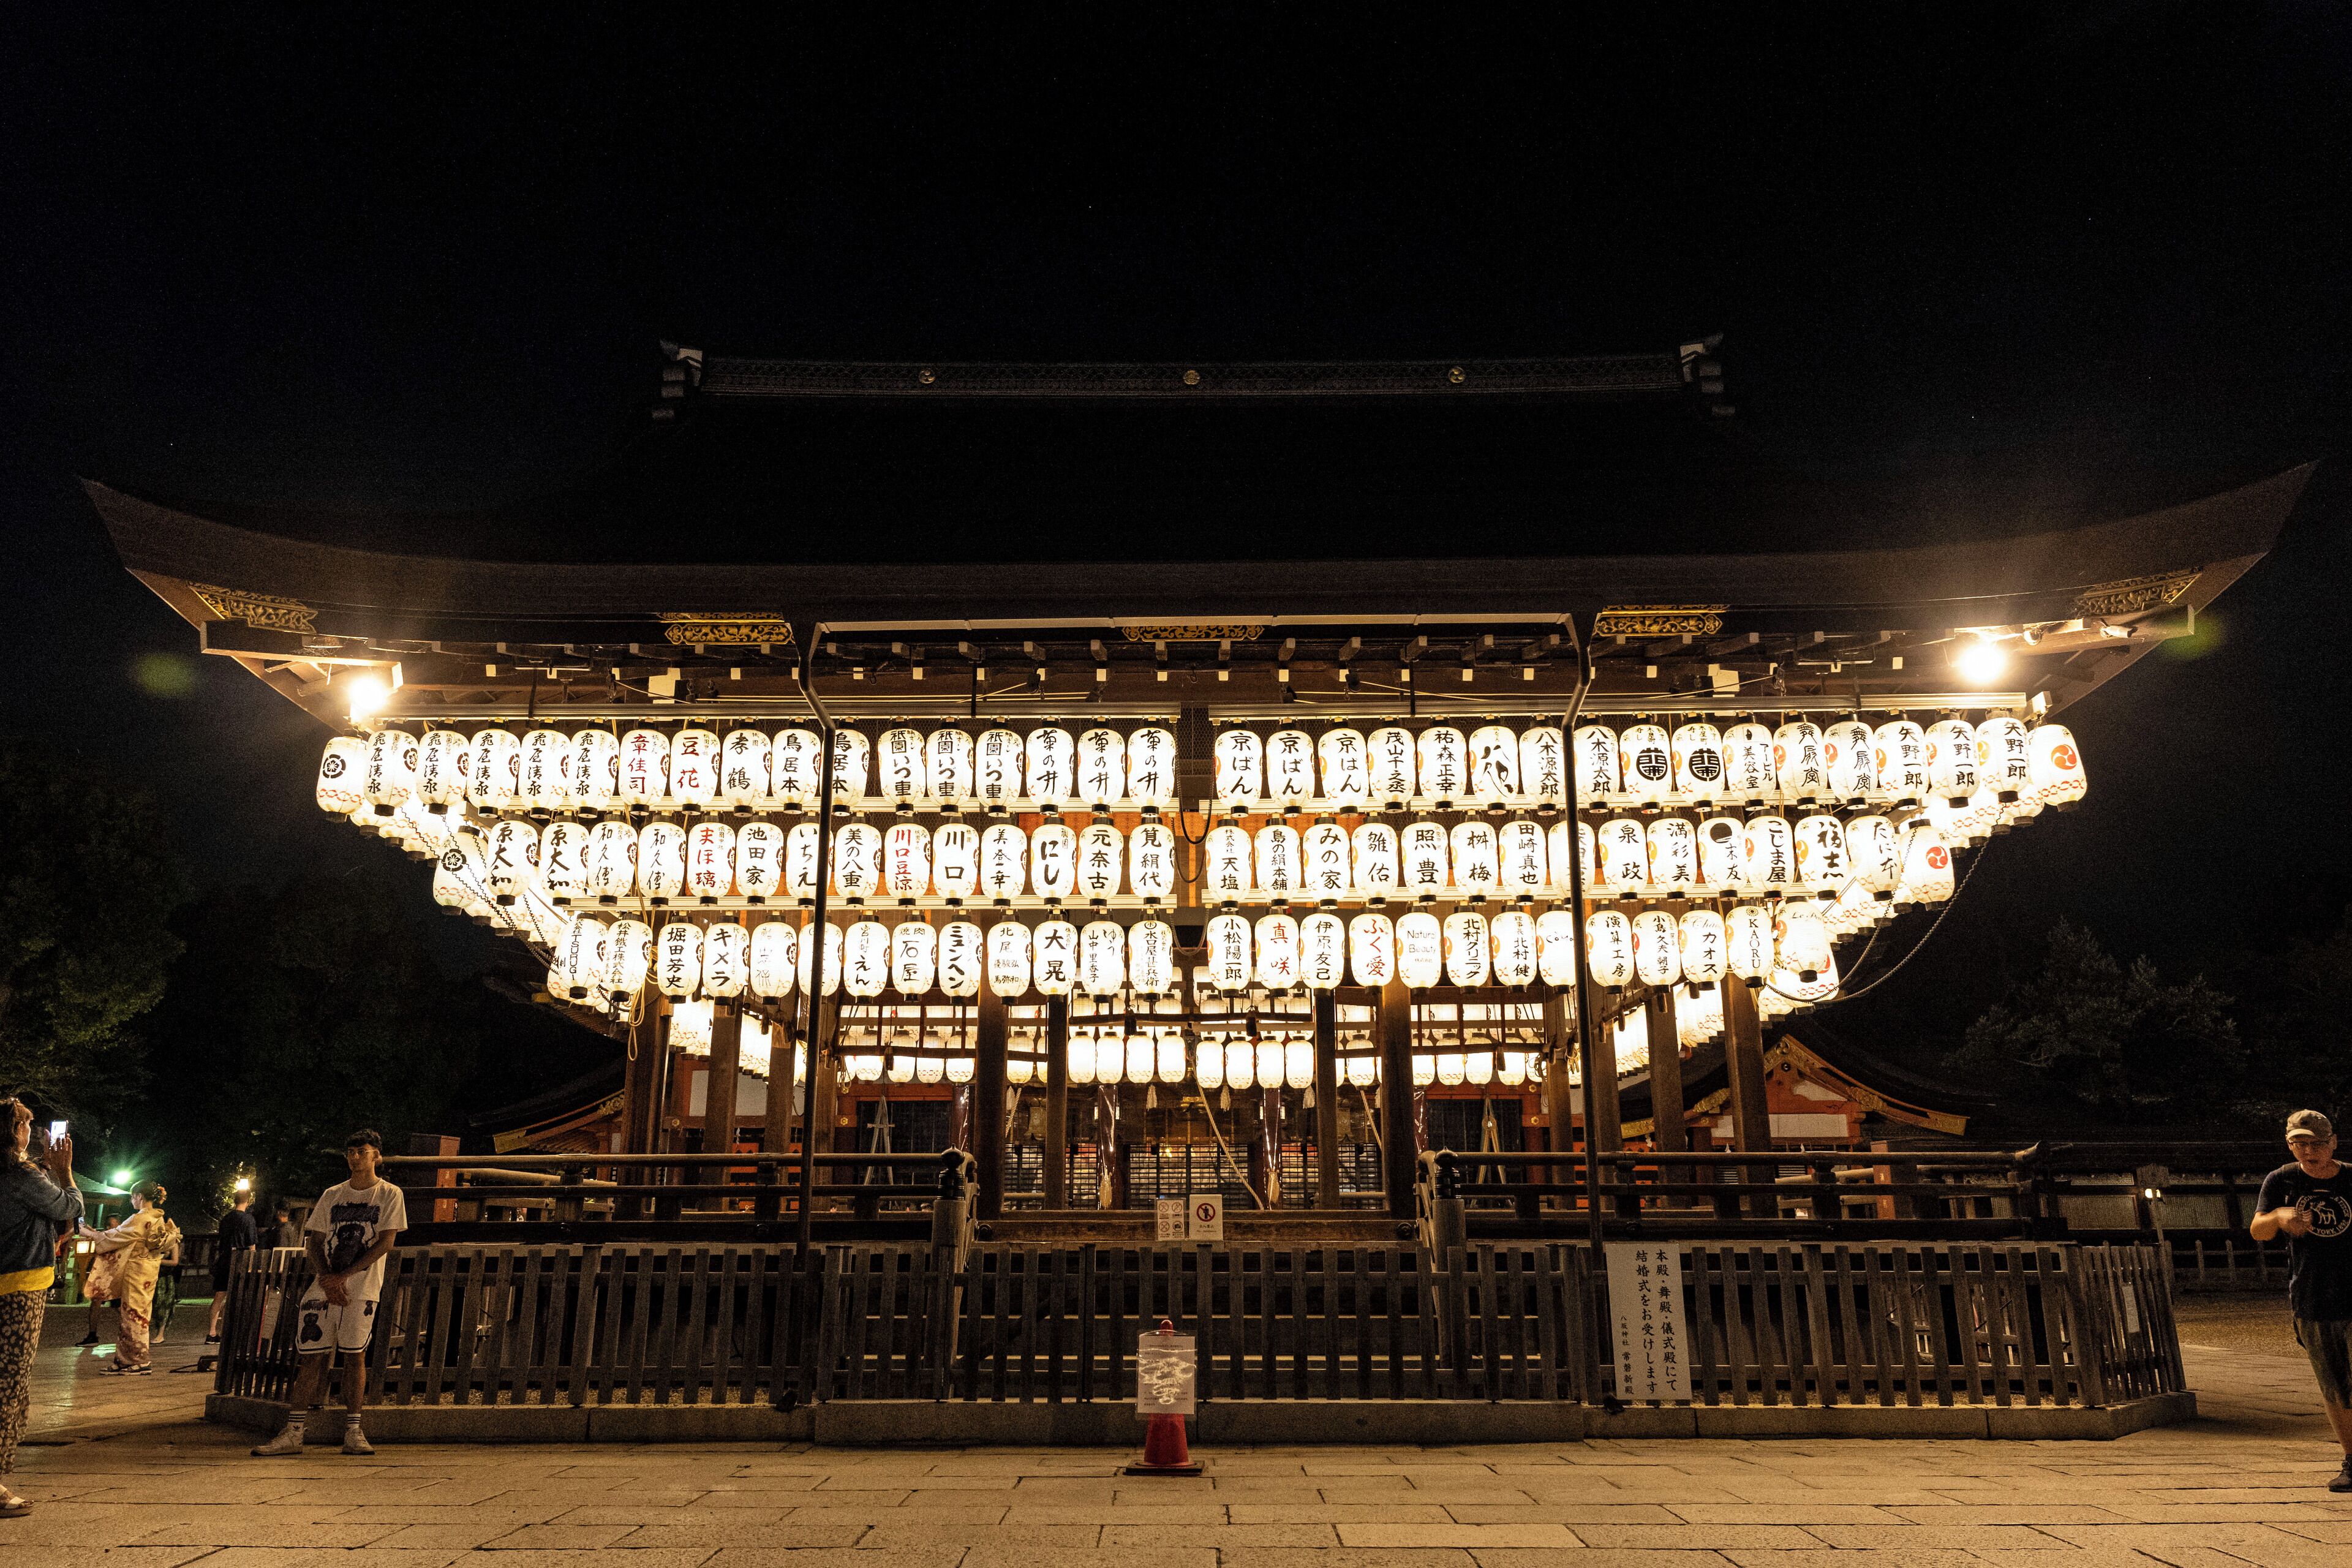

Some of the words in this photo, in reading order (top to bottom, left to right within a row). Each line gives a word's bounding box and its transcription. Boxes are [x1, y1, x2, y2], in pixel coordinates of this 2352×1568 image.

[677, 736, 699, 790] 豆花
[780, 733, 802, 793] 鳥居本
[1230, 733, 1253, 794] 京ばん
[1279, 733, 1304, 796] 京ばん
[1386, 731, 1407, 794] 茂山千之丞
[1535, 731, 1560, 799] 八木源太郎
[1587, 728, 1612, 798] 八木源太郎
[1743, 745, 1760, 790] 美容室
[1760, 743, 1774, 782] アービル
[1899, 726, 1923, 790] 矢野一郎
[1950, 725, 1975, 788] 矢野一郎
[2004, 721, 2026, 781] 矢野一郎
[746, 827, 767, 885] 池田家
[842, 828, 864, 888] 美の八重
[945, 831, 965, 880] 川口
[1041, 840, 1060, 886] にし
[1088, 829, 1112, 890] 元奈古
[1221, 858, 1239, 890] 天塩
[1271, 829, 1287, 891] 島の絹本舗
[1321, 828, 1342, 889] みの家
[1415, 829, 1439, 884] 照豊
[1518, 824, 1539, 884] 田崎真也
[1619, 824, 1643, 880] 泉政
[1766, 820, 1787, 883] こじま屋
[666, 927, 687, 988] 堀田芳史
[712, 928, 734, 987] キメラ
[899, 927, 926, 936] 焼肉
[901, 940, 920, 982] 石屋
[948, 925, 965, 990] ミュンヘン
[1000, 927, 1014, 954] 北尾
[1043, 929, 1067, 982] 大晃
[1089, 930, 1099, 983] 山中里香子
[1223, 918, 1243, 981] 小松陽一郎
[1270, 922, 1291, 976] 真咲
[1315, 921, 1335, 981] 伊原友己
[1364, 919, 1385, 977] ふく愛
[1409, 944, 1436, 954] Beauty
[1463, 919, 1482, 979] 北村クリニック
[1605, 916, 1626, 978] 演算工房
[1702, 932, 1717, 974] カオス
[1749, 919, 1760, 968] KAORU
[854, 954, 871, 986] えん
[1635, 1250, 1657, 1393] 結婚式をお受けします
[1655, 1249, 1676, 1391] 本殿・舞殿・儀式殿にて
